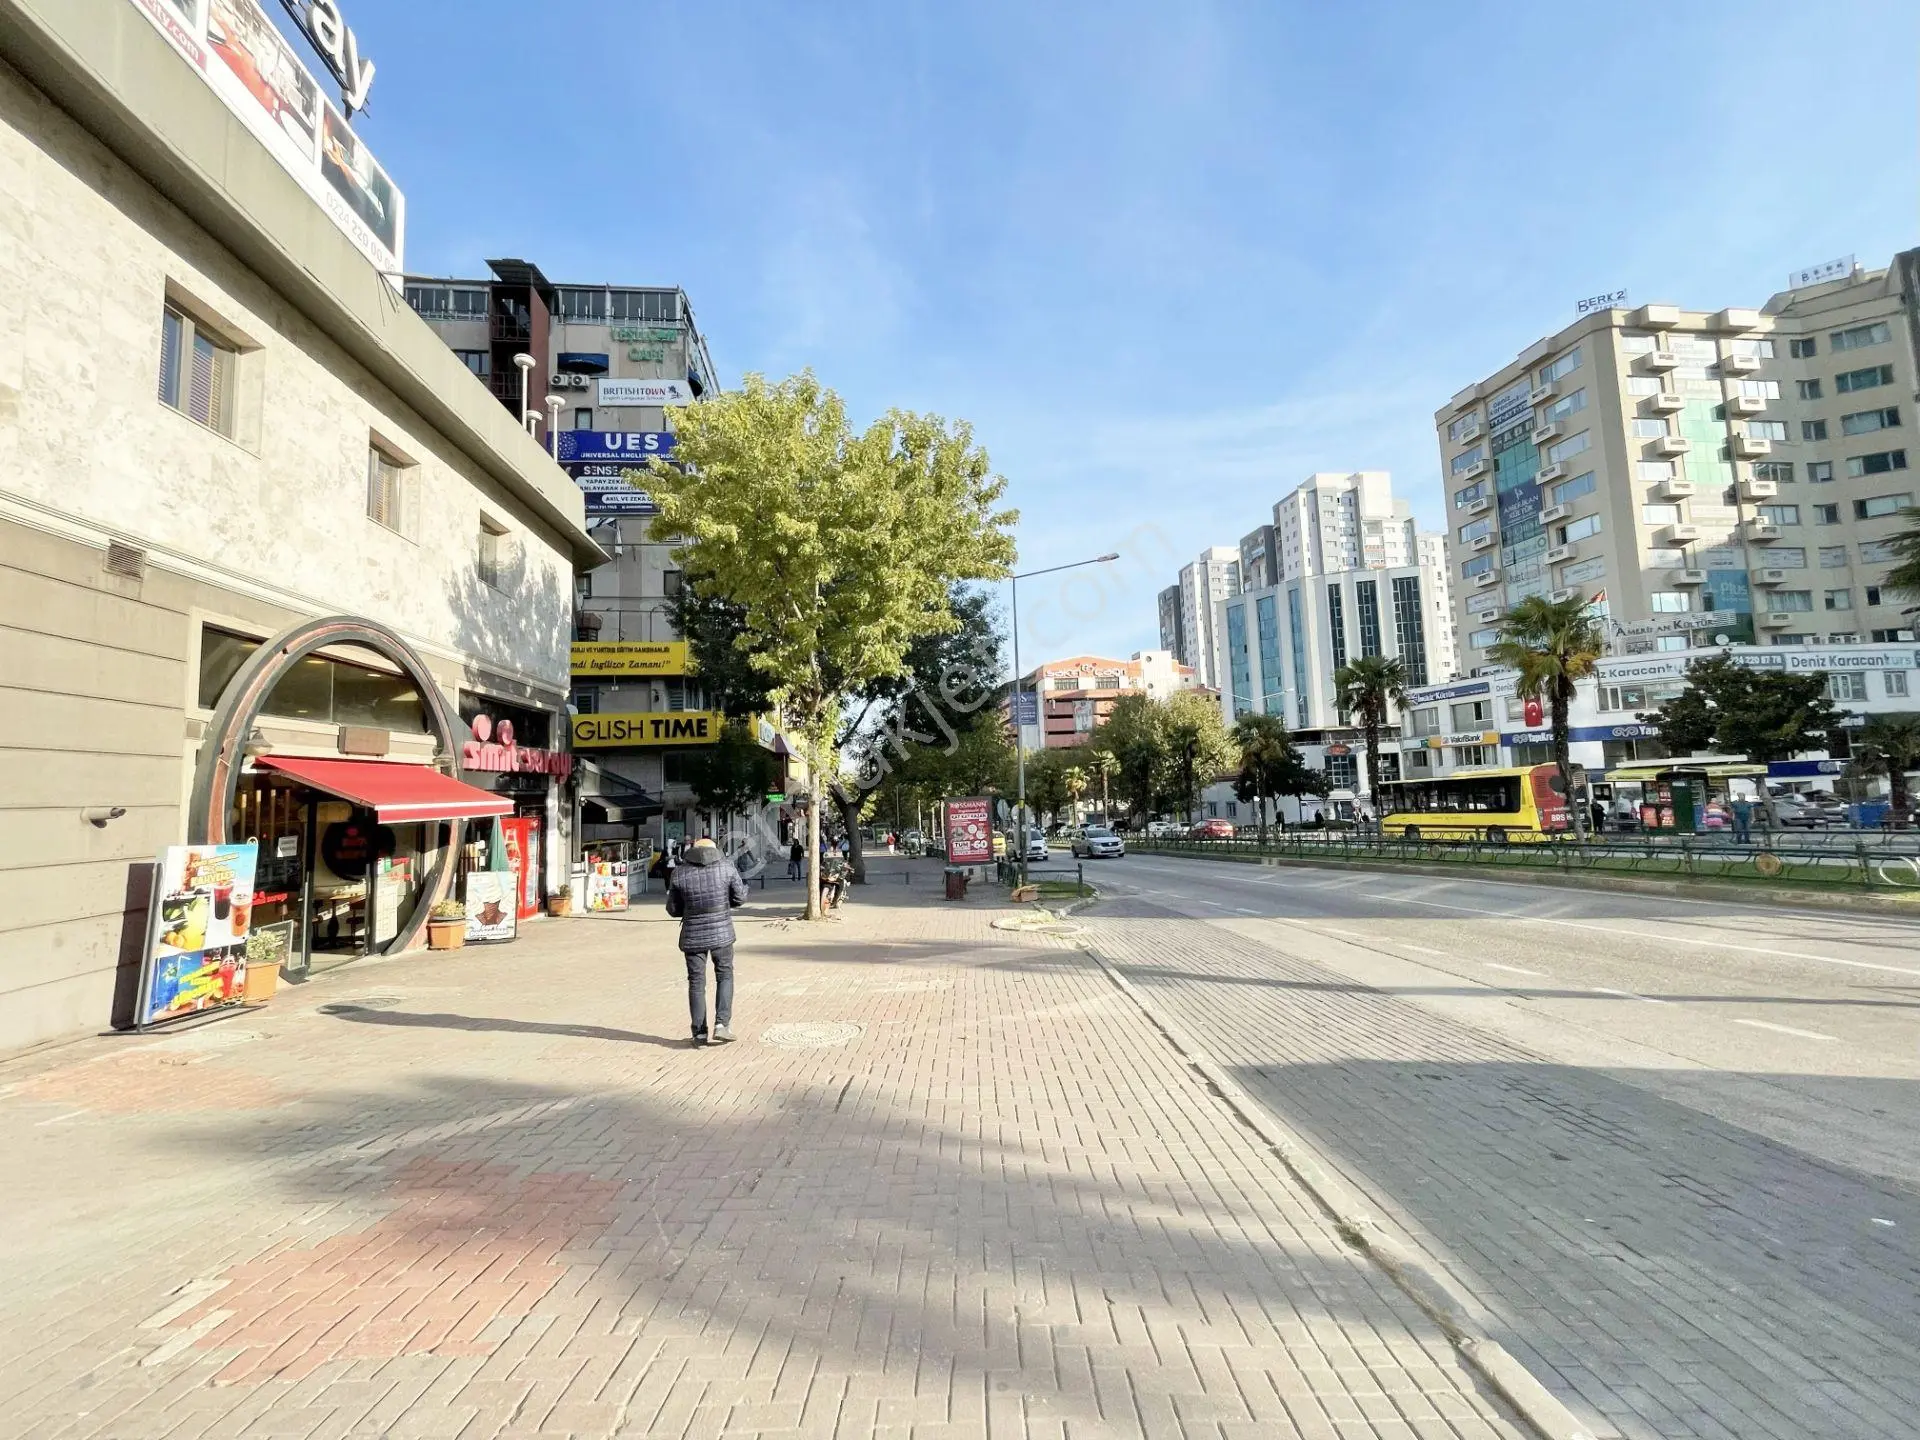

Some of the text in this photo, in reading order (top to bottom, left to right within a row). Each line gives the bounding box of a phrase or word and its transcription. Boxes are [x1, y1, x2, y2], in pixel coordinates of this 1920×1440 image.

[1577, 290, 1625, 313] BERK 2
[603, 387, 666, 396] BRITISHTOWN
[605, 432, 659, 451] UES
[1791, 655, 1826, 668] Deniz
[1828, 654, 1884, 667] Karacan
[574, 718, 708, 741] GLISH TIME
[1639, 725, 1662, 737] Yap
